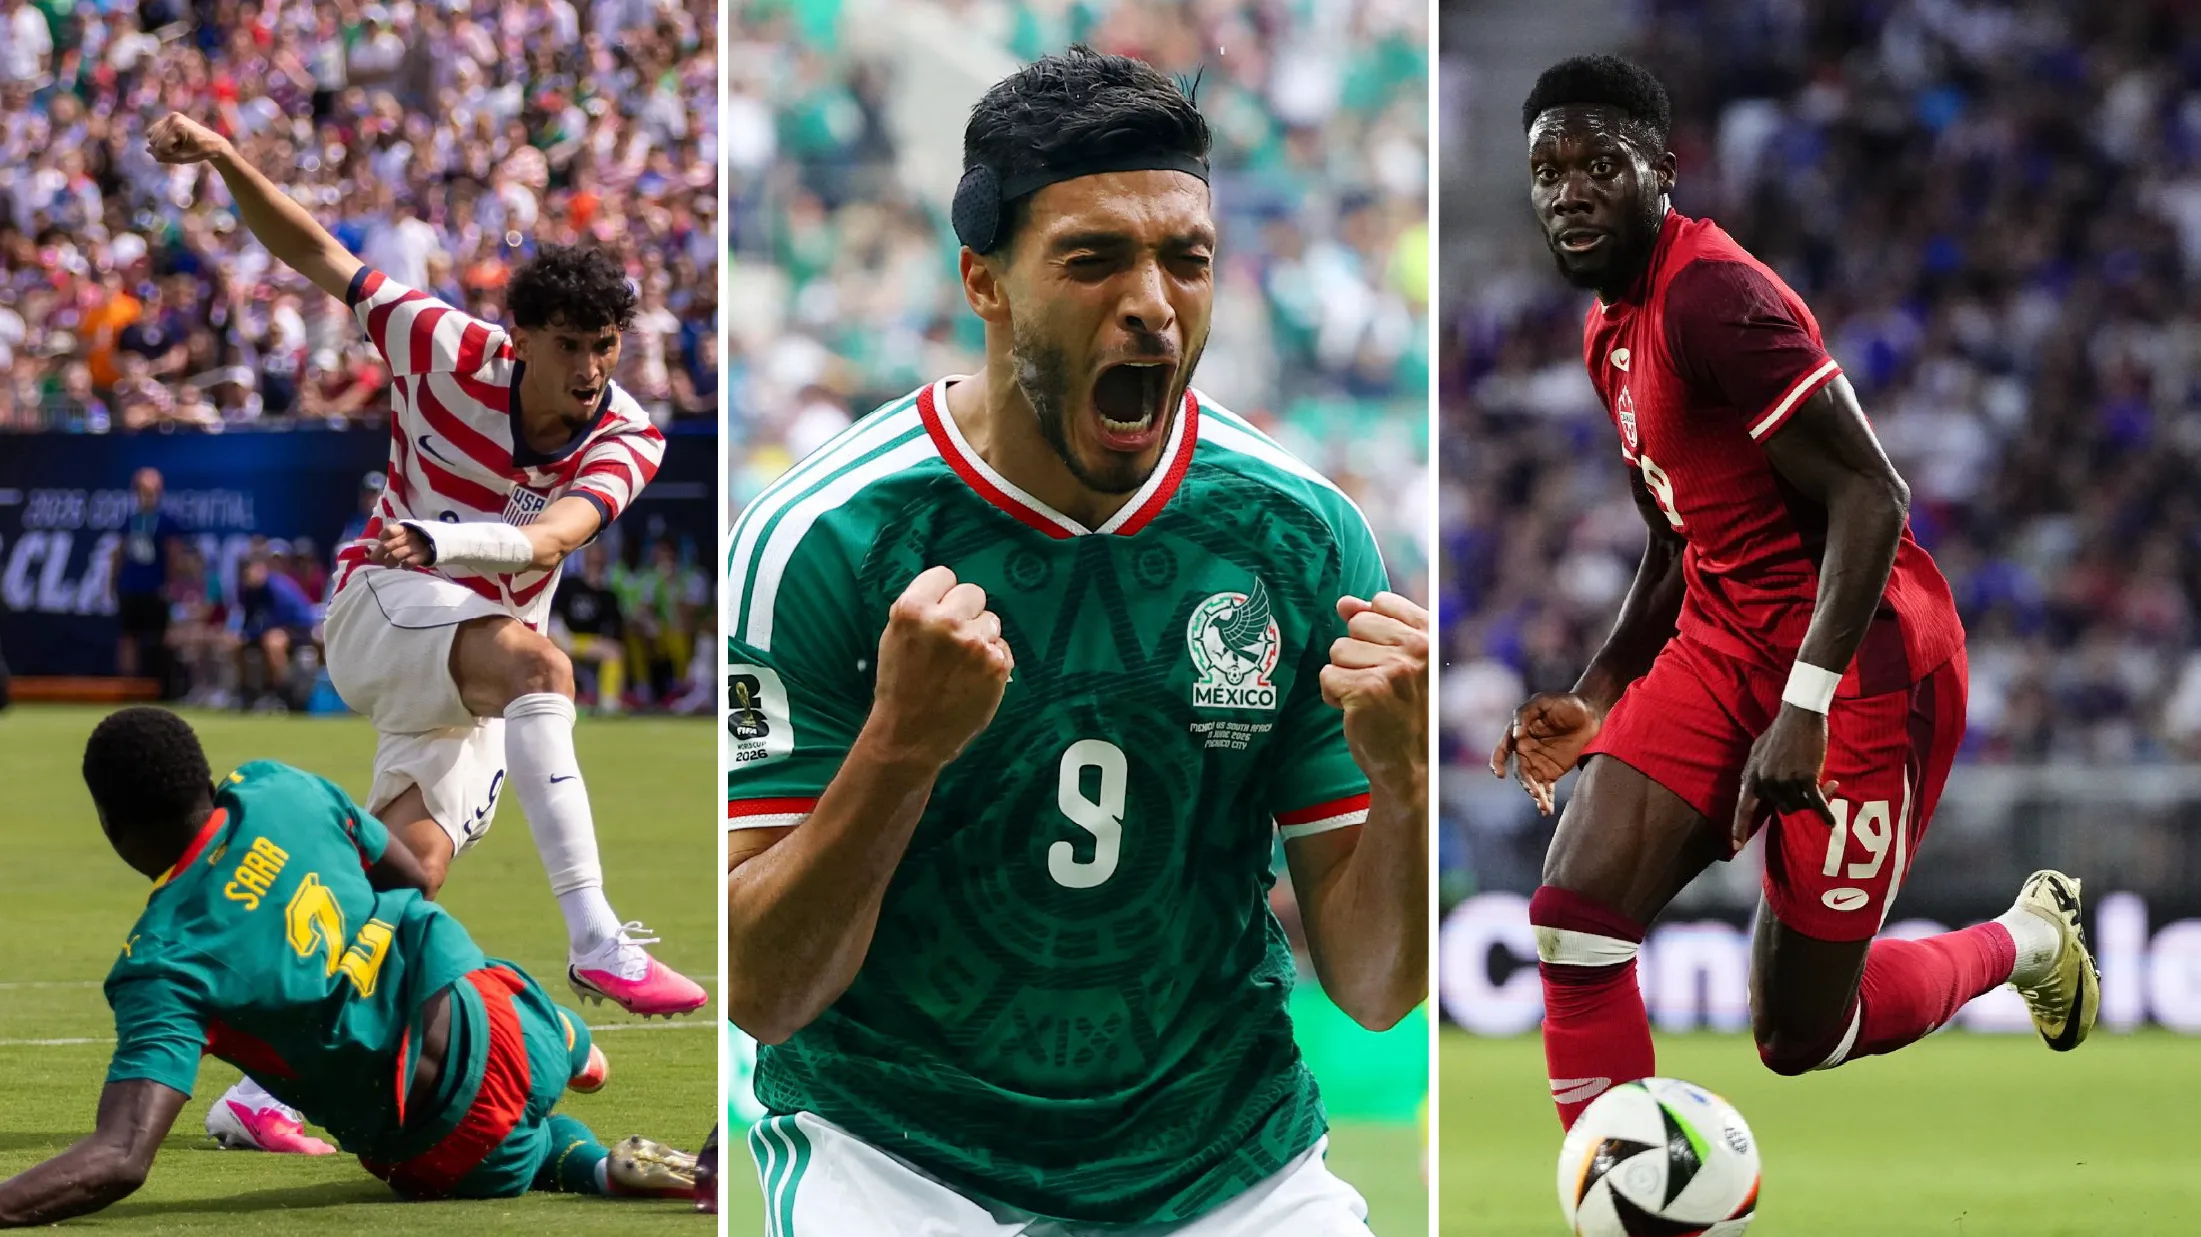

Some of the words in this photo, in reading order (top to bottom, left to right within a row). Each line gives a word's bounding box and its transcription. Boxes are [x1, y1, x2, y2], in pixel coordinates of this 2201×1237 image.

[513, 488, 546, 512] USA
[1195, 683, 1274, 706] MÉXICO
[736, 726, 758, 736] FIFA
[1226, 722, 1250, 732] SOUTH
[1230, 731, 1251, 741] 2026
[1231, 741, 1248, 750] CITY
[735, 749, 769, 762] 2026
[1048, 738, 1128, 889] 9
[1823, 798, 1892, 879] 19
[224, 836, 290, 911] SARR
